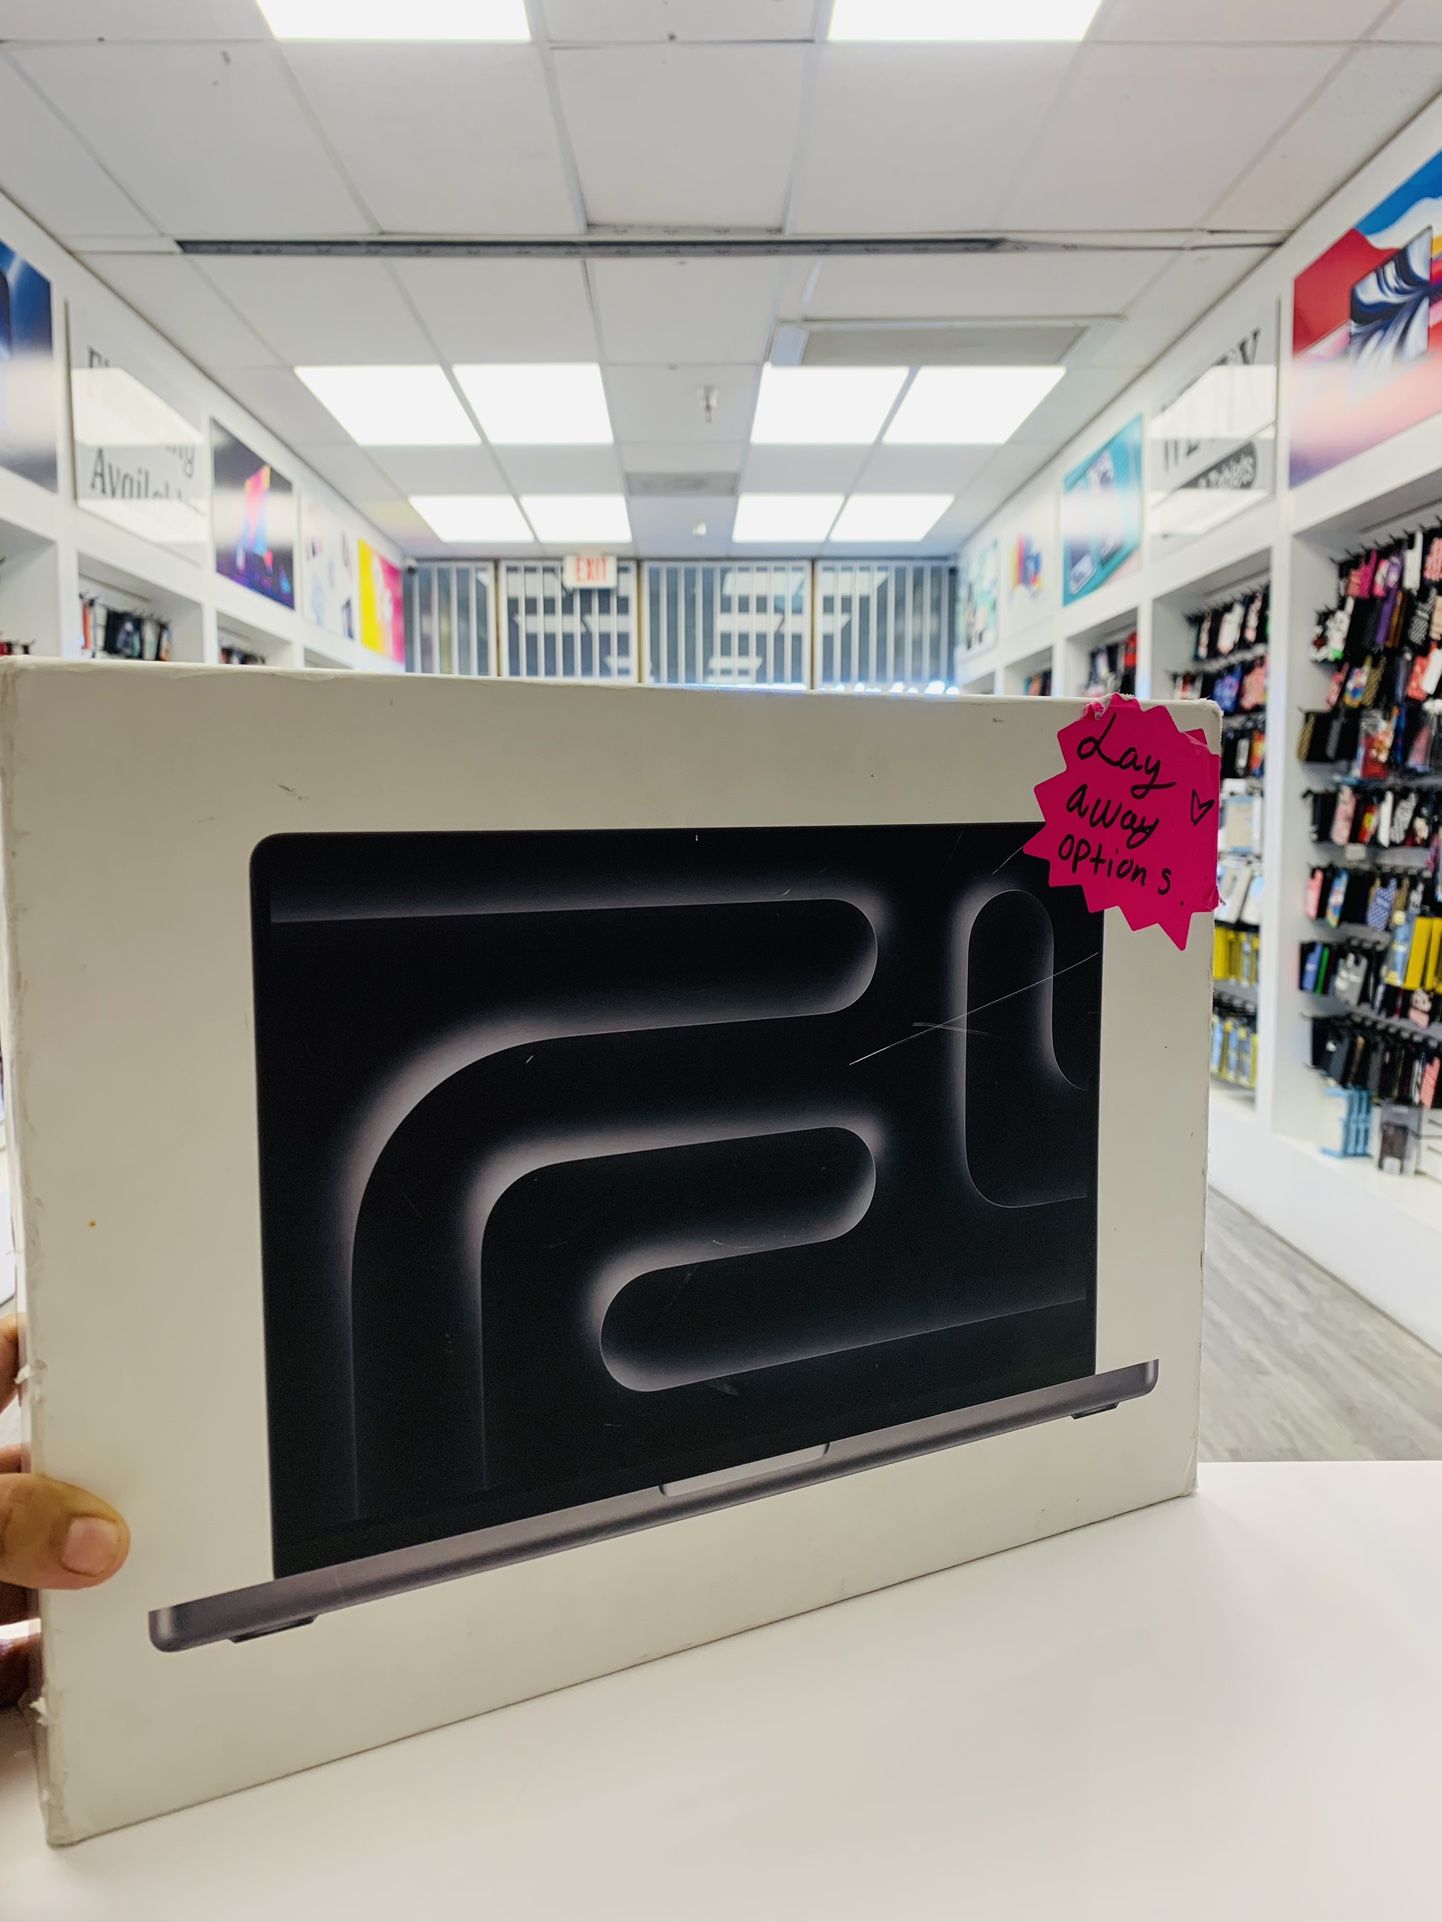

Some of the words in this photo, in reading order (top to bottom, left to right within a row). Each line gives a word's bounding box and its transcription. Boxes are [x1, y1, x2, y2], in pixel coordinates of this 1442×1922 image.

[576, 556, 608, 581] EXIT
[1076, 712, 1177, 800] Lay
[1065, 783, 1160, 850] away
